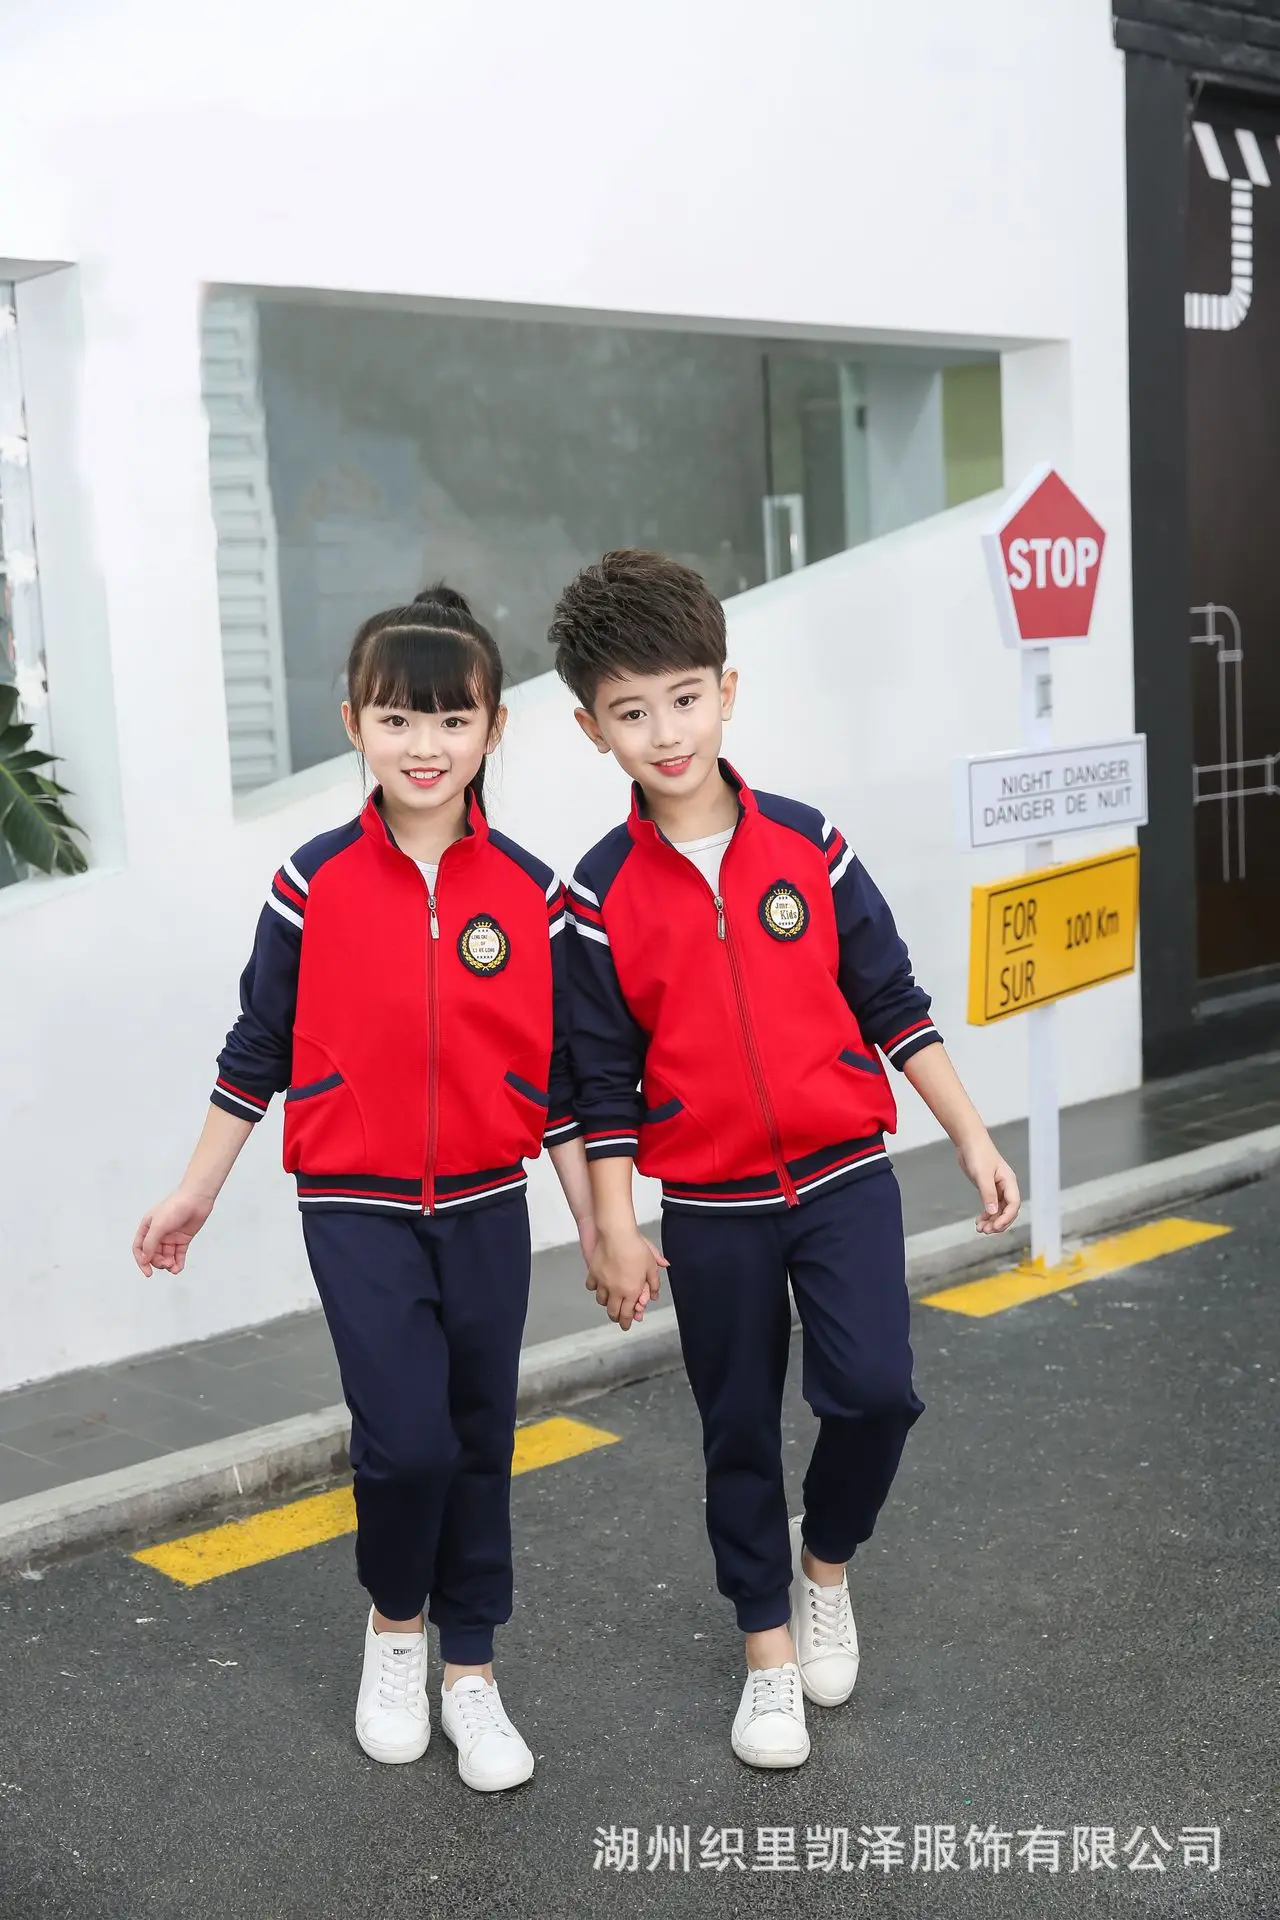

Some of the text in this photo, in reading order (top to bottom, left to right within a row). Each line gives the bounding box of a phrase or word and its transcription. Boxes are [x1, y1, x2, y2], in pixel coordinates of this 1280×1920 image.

[1008, 536, 1099, 591] STOP
[1001, 759, 1130, 796] NIGHT DANGER
[983, 785, 1132, 828] DANGER DE NUIT
[780, 909, 798, 920] Kids
[1002, 898, 1038, 946] FOR
[1065, 905, 1120, 950] 100 Km
[999, 959, 1036, 1007] SUR
